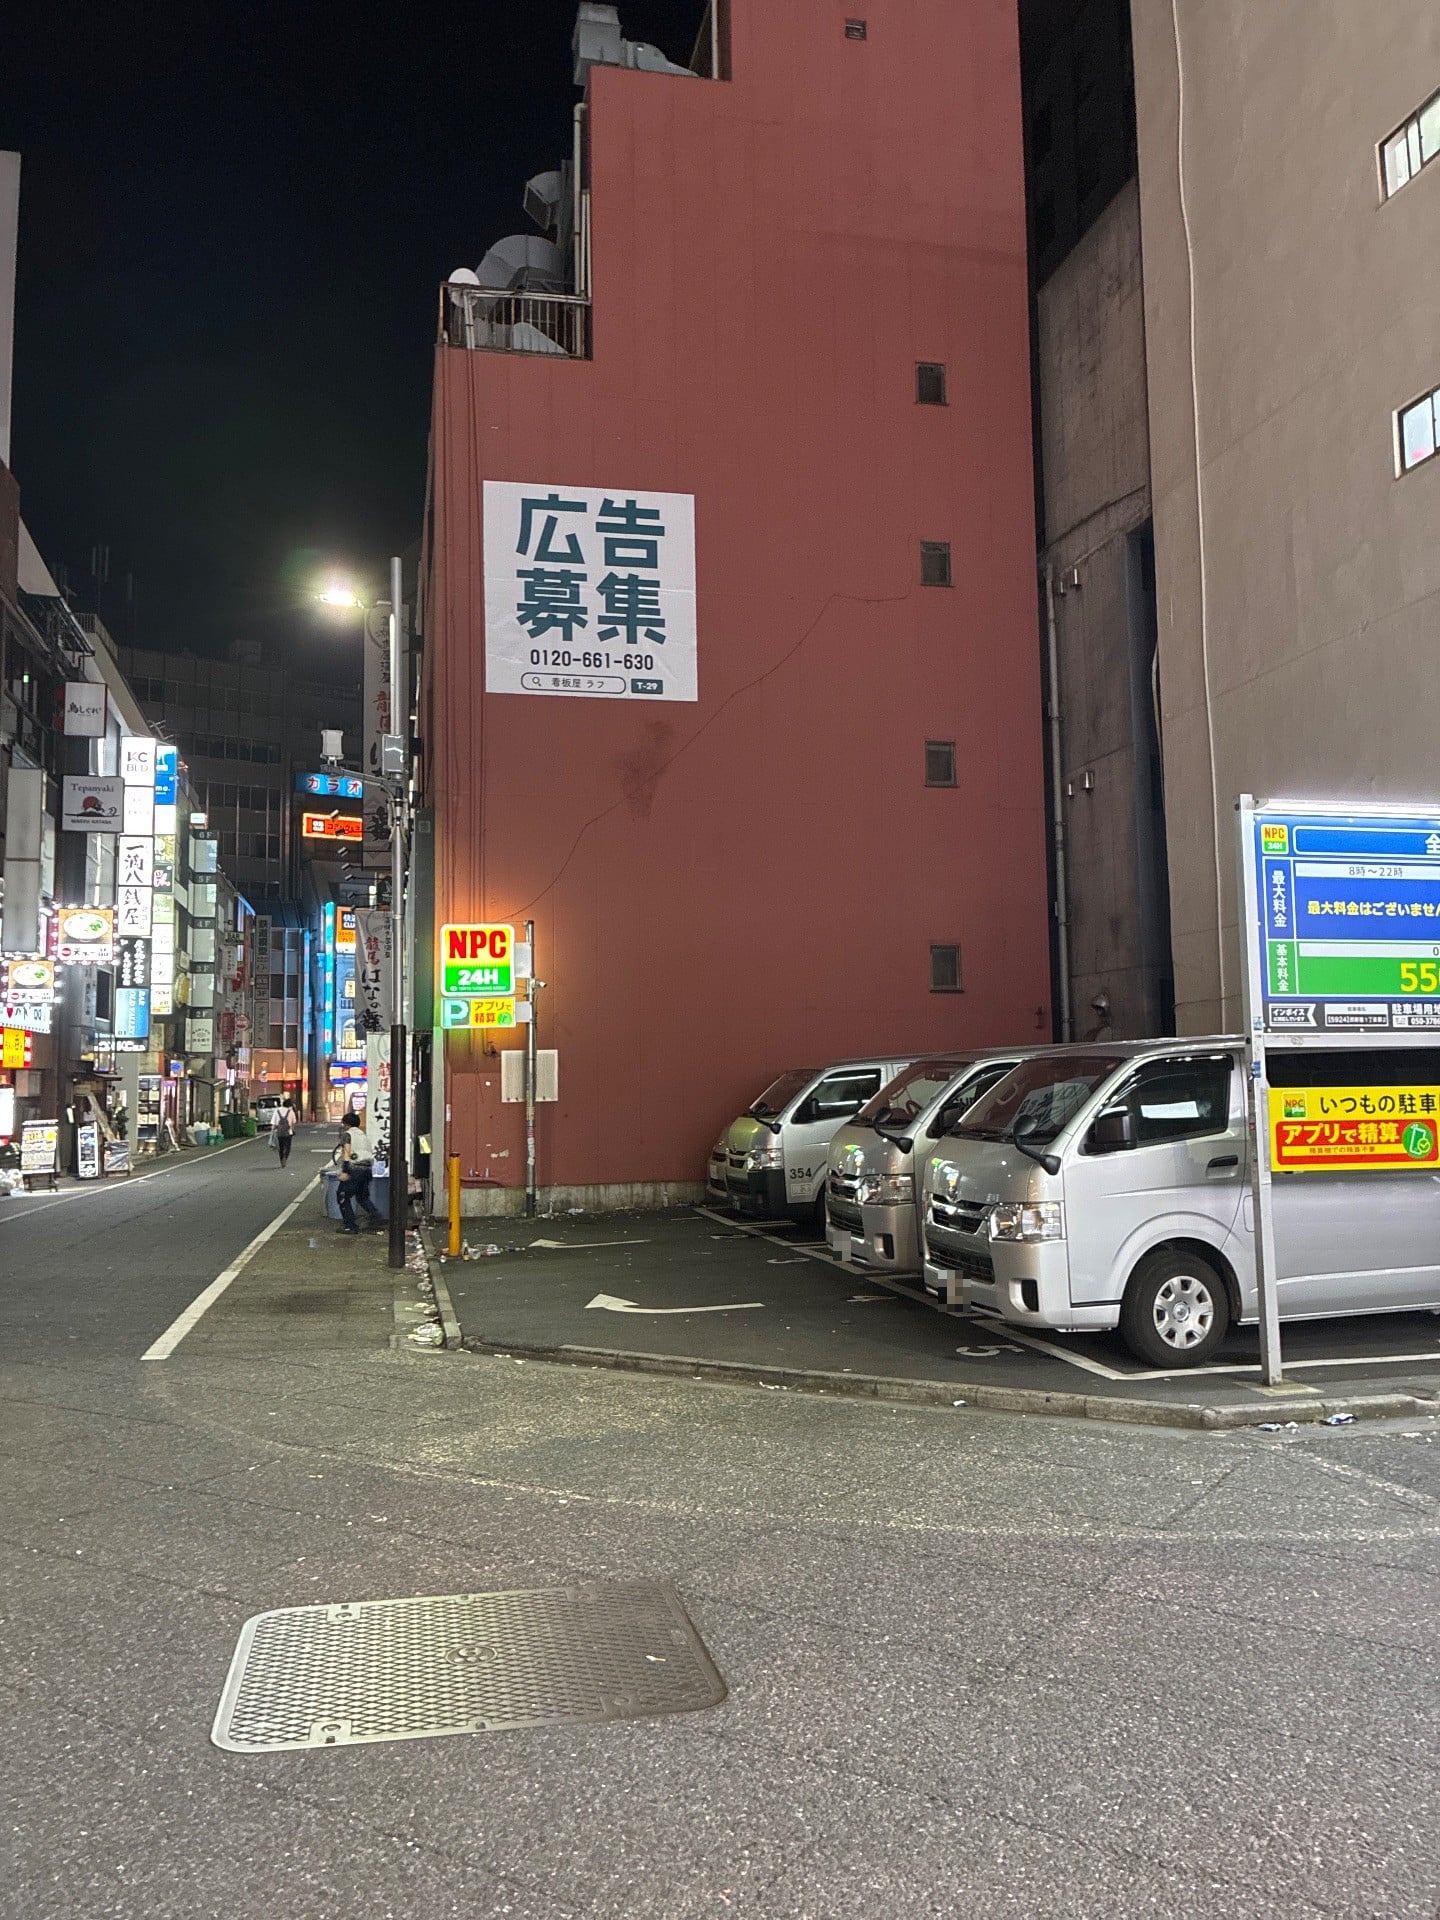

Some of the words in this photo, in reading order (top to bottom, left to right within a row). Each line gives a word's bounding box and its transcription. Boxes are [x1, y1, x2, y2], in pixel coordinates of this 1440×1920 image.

[516, 493, 665, 569] 広告
[516, 567, 667, 645] 募集
[530, 648, 654, 671] 0120-661-630
[551, 677, 582, 688] 看板屋
[586, 679, 605, 689] ラフ
[635, 681, 658, 691] T-29
[127, 751, 149, 763] KC
[71, 782, 115, 794] Tepanyaki
[1264, 827, 1286, 839] NPC
[1267, 842, 1283, 850] 24H
[1271, 869, 1288, 928] 最大料金
[449, 930, 506, 959] NPC
[1276, 943, 1289, 992] 基本料金
[458, 968, 499, 985] 24H
[1400, 962, 1440, 992] 55
[443, 1000, 470, 1027] P
[474, 1001, 511, 1012] アプリで
[1273, 1008, 1306, 1017] インボイス
[474, 1012, 496, 1024] 精算
[1284, 1099, 1304, 1108] NPC
[1320, 1093, 1440, 1114] いつもの駐車
[1282, 1122, 1400, 1144] アプリで精算
[789, 1167, 812, 1180] 354
